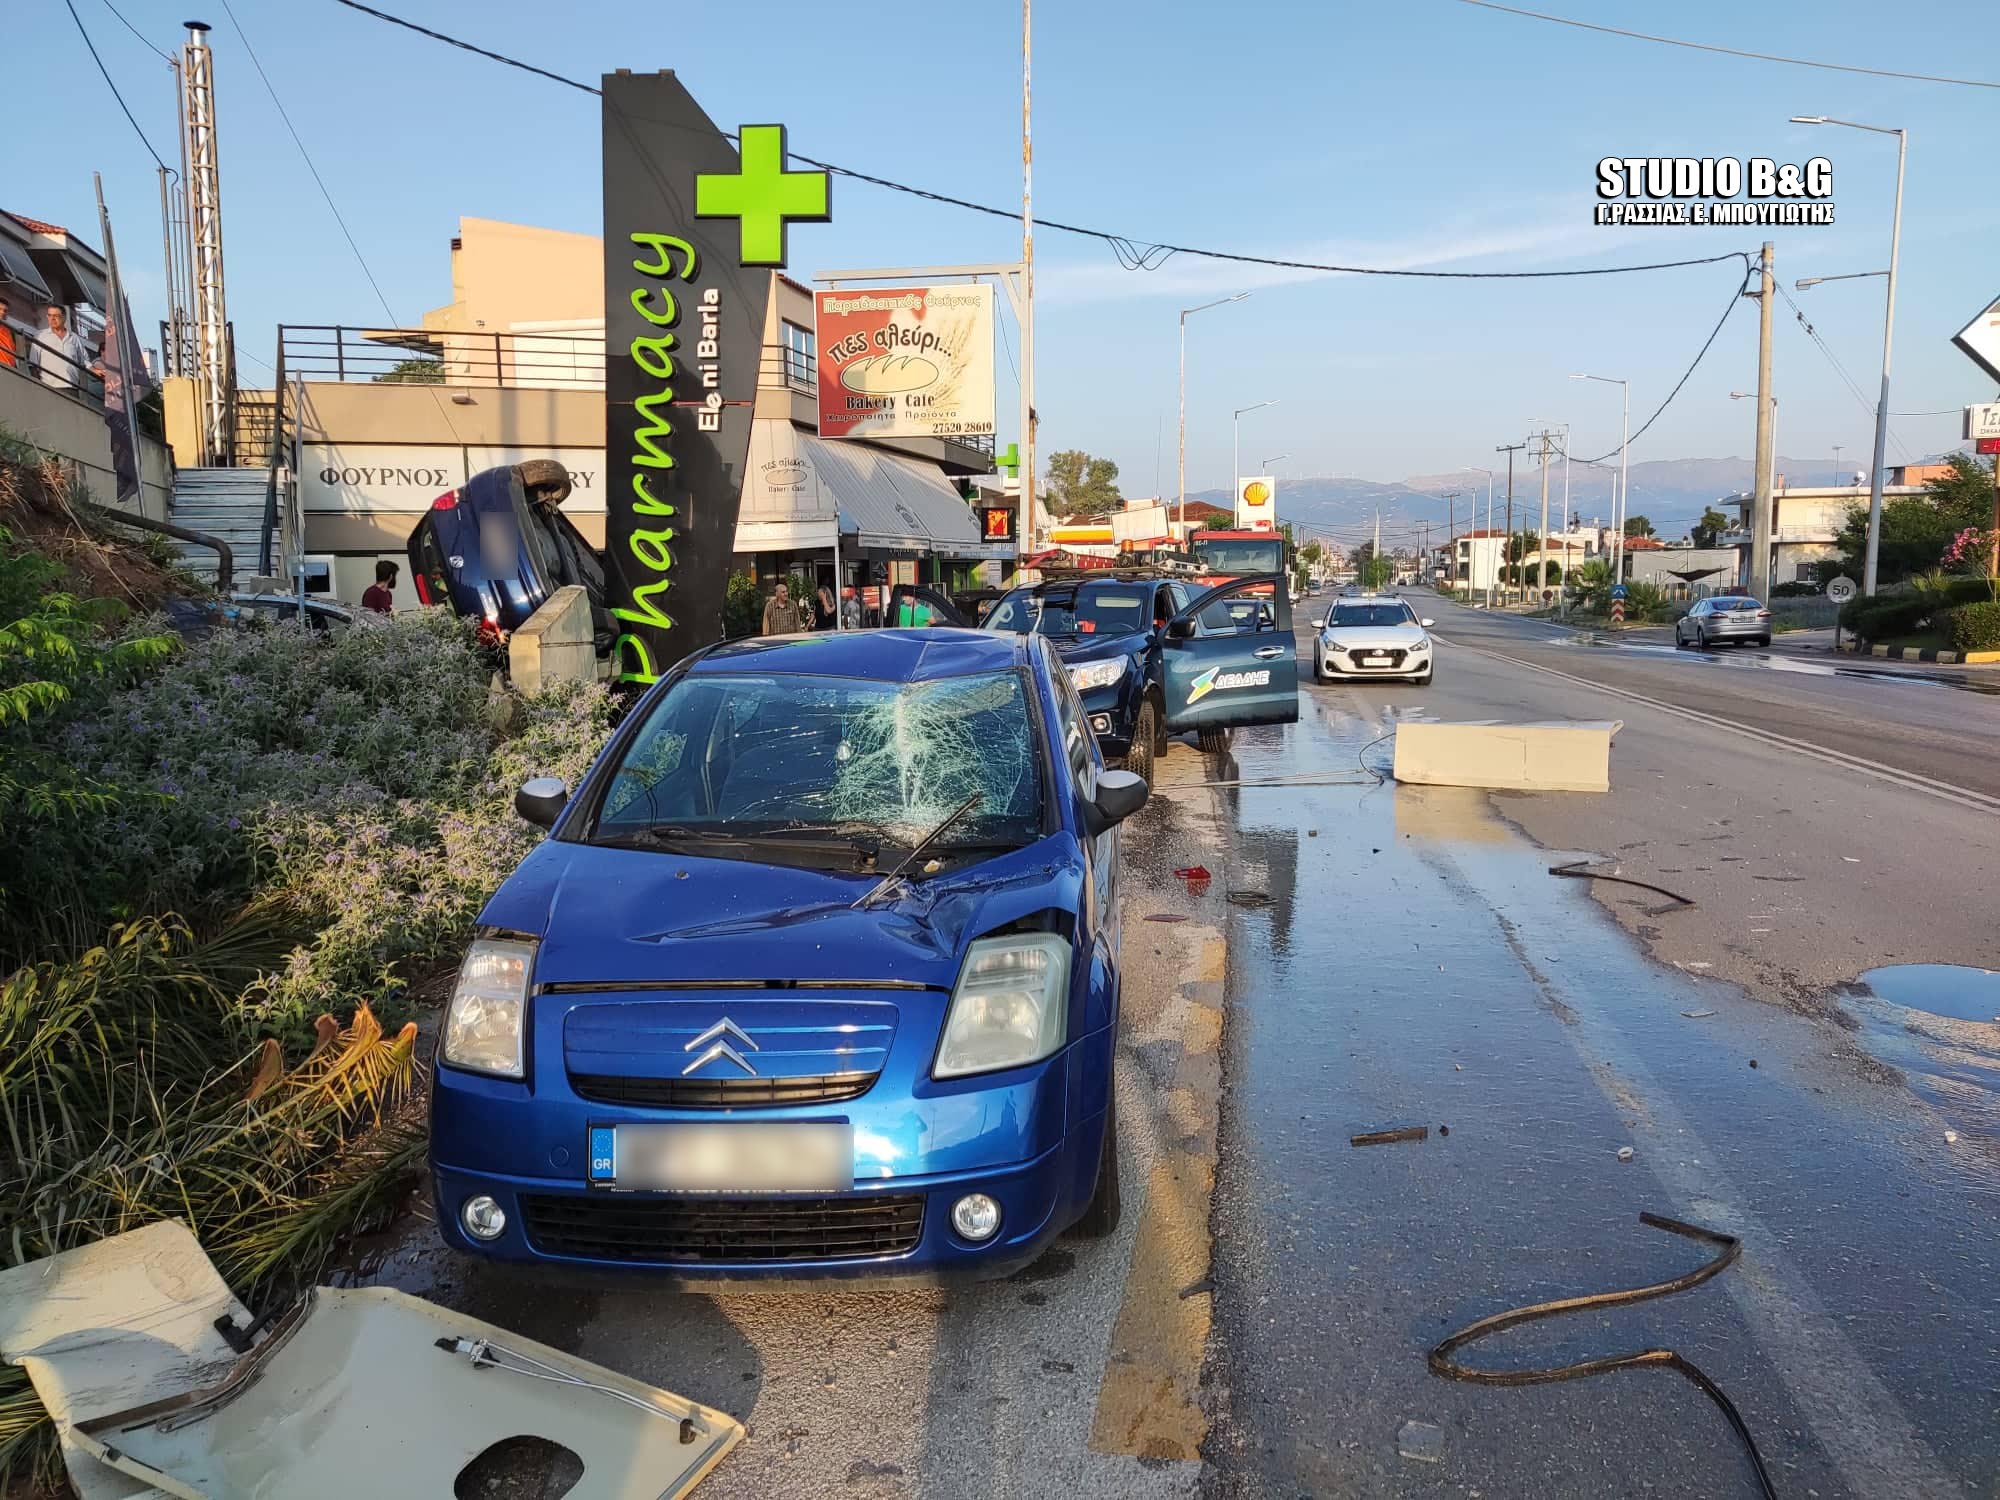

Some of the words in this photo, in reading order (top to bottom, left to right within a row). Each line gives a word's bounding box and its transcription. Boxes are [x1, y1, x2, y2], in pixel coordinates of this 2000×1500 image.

[696, 288, 719, 358] Barla
[845, 396, 896, 410] Bakery
[905, 394, 935, 407] Cafe
[932, 422, 962, 433] 27520
[610, 231, 697, 684] Pharmacy
[319, 467, 449, 487] ΦΟΥΡΝΟΣ
[1832, 584, 1850, 596] 50
[593, 1158, 611, 1170] GR
